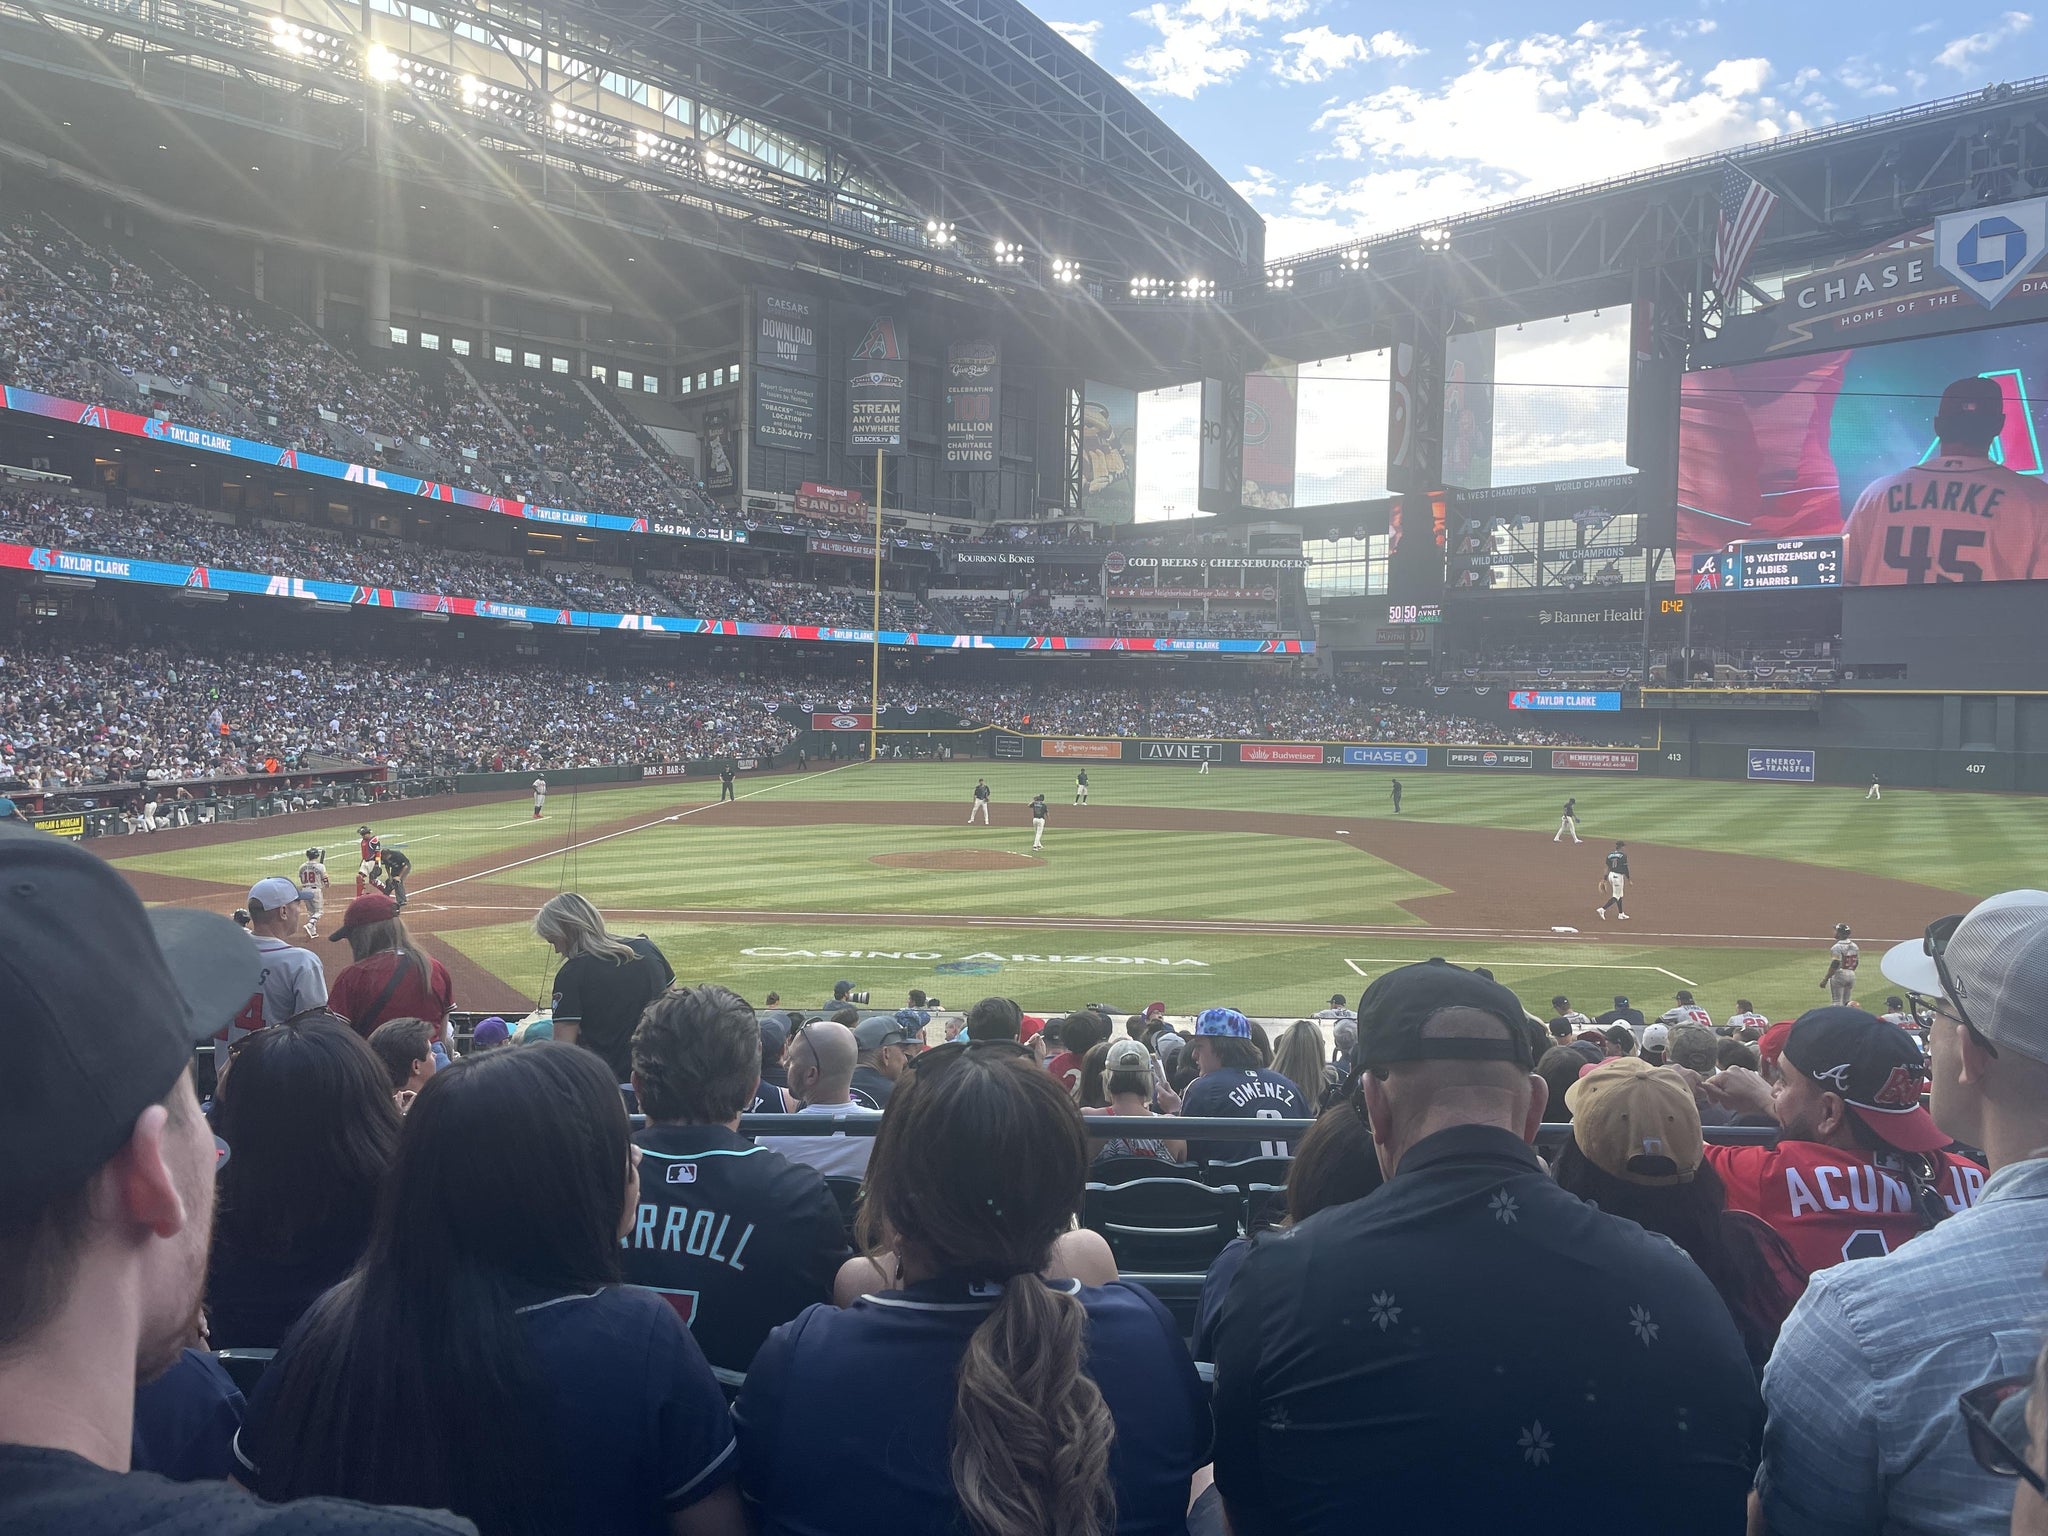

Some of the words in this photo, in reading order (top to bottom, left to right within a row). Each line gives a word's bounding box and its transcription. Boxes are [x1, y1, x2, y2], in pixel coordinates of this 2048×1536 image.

[1797, 259, 1924, 310] CHASE
[767, 296, 809, 315] CAESARS
[1841, 308, 1885, 327] HOME
[1896, 302, 1915, 314] OF
[1929, 294, 1958, 307] THE
[762, 318, 813, 346] DOWNLOAD
[777, 340, 799, 361] NOW
[760, 382, 778, 391] Report
[852, 404, 900, 414] STREAM
[772, 412, 803, 423] LOCATION
[852, 416, 872, 424] ANY
[874, 416, 900, 424] GAME
[761, 425, 813, 440] 623.304.0777
[852, 425, 900, 433] ANYWHERE
[947, 423, 993, 432] MILLION
[170, 426, 200, 445] TAYLOR
[201, 433, 232, 451] CLARKE
[947, 450, 993, 461] GIVING
[1554, 482, 1582, 492] WORLD
[1584, 476, 1633, 490] CHAMPIONS
[816, 486, 848, 497] Honeywell
[1456, 492, 1467, 501] NL
[1468, 490, 1489, 500] WEST
[1491, 486, 1537, 499] CHAMPIONS
[1888, 480, 2006, 518] CLARKE
[799, 497, 867, 516] SANDLOT
[537, 509, 561, 521] TAYLOR
[562, 512, 588, 524] CLARKE
[654, 523, 674, 534] 5:42
[676, 526, 691, 536] PM
[1727, 545, 1734, 553] R
[1793, 541, 1803, 549] UP
[958, 554, 997, 563] BOURBON
[998, 554, 1006, 562] &
[1008, 554, 1035, 564] BONES
[1559, 551, 1569, 560] NL
[1572, 547, 1624, 558] CHAMPIONS
[1744, 555, 1755, 564] 18
[1756, 551, 1817, 563] YASTRZEMSKI
[1820, 550, 1836, 559] 0-1
[1883, 525, 1986, 585] 45
[28, 547, 50, 571] 45
[58, 555, 92, 572] TAYLOR
[95, 559, 130, 576] CLARKE
[1128, 558, 1158, 567] COLD
[1161, 558, 1198, 568] BEERS
[1201, 559, 1207, 568] &
[1210, 558, 1310, 569] CHEESEBURGERS
[1471, 556, 1491, 566] WILD
[1492, 555, 1514, 564] CARD
[1726, 558, 1733, 569] 1
[1747, 567, 1751, 575] 1
[1756, 565, 1788, 575] ALBIES
[1818, 563, 1836, 572] 0-2
[1725, 575, 1734, 586] 2
[1744, 578, 1754, 587] 23
[1756, 576, 1790, 586] HARRIS
[1819, 575, 1836, 583] 1-2
[490, 604, 507, 616] TAYLOR
[508, 606, 527, 618] CLARKE
[1661, 600, 1683, 612] 0:42
[1554, 610, 1600, 623] Banner
[1603, 608, 1644, 622] Health
[834, 630, 853, 640] TAYLOR
[853, 631, 873, 641] CLARKE
[1173, 641, 1195, 649] TAYLOR
[1196, 641, 1220, 650] CLARKE
[1512, 692, 1530, 708] 45
[1536, 695, 1564, 705] TAYLOR
[1566, 696, 1597, 706] CLARKE
[1068, 744, 1089, 752] Dignity
[1150, 744, 1213, 759] AVNET
[1272, 751, 1316, 761] Budweiser
[1326, 756, 1341, 764] 374
[1353, 751, 1402, 762] CHASE
[1451, 754, 1477, 762] PEPSI
[1503, 756, 1529, 764] PEPSI
[1569, 754, 1610, 762] MEMBERSHIPS
[1667, 753, 1682, 762] 413
[1766, 758, 1802, 766] ENERGY
[643, 765, 663, 776] BAR-S
[666, 764, 685, 774] BAR-S
[1766, 764, 1811, 773] TRANSFER
[1966, 764, 1986, 774] 407
[35, 820, 55, 830] MORGAN
[60, 817, 80, 828] MORGAN
[303, 871, 316, 884] 18
[740, 946, 942, 961] CASINO
[963, 949, 1210, 967] ARIZONA
[1688, 1011, 1710, 1026] 15
[1228, 1079, 1295, 1108] GIMÉNEZ
[619, 1203, 755, 1272] RROLL
